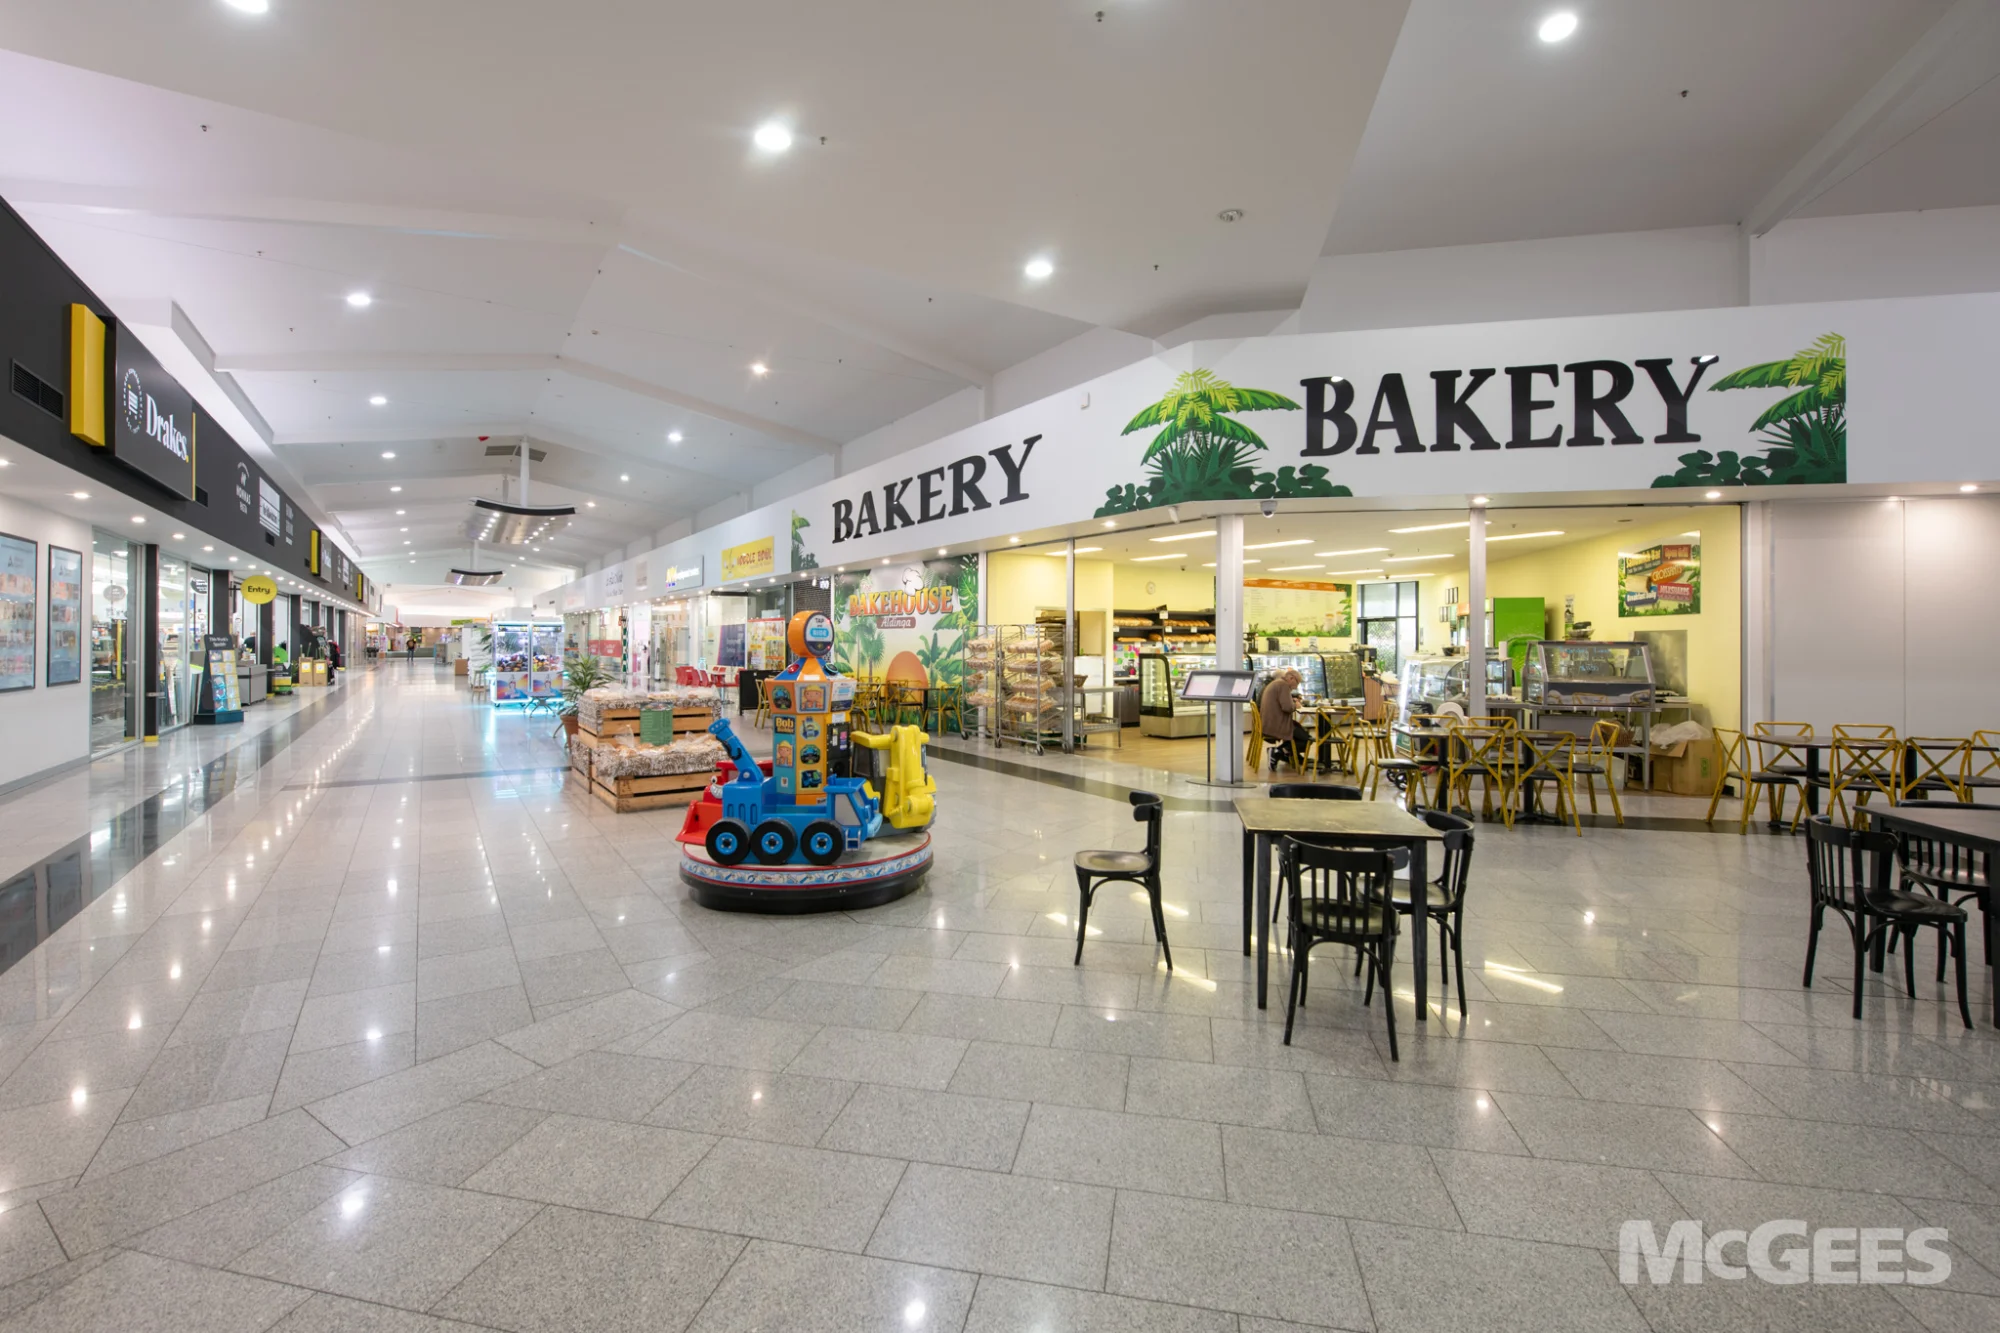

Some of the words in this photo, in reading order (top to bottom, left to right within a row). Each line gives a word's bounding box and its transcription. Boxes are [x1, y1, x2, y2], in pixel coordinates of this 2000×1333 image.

[1300, 354, 1719, 457] BAKERY
[832, 434, 1043, 544] BAKERY
[247, 586, 271, 594] Entry
[849, 586, 953, 617] BAKEHOUSE
[881, 617, 912, 629] Aldinga
[775, 717, 794, 728] Bob
